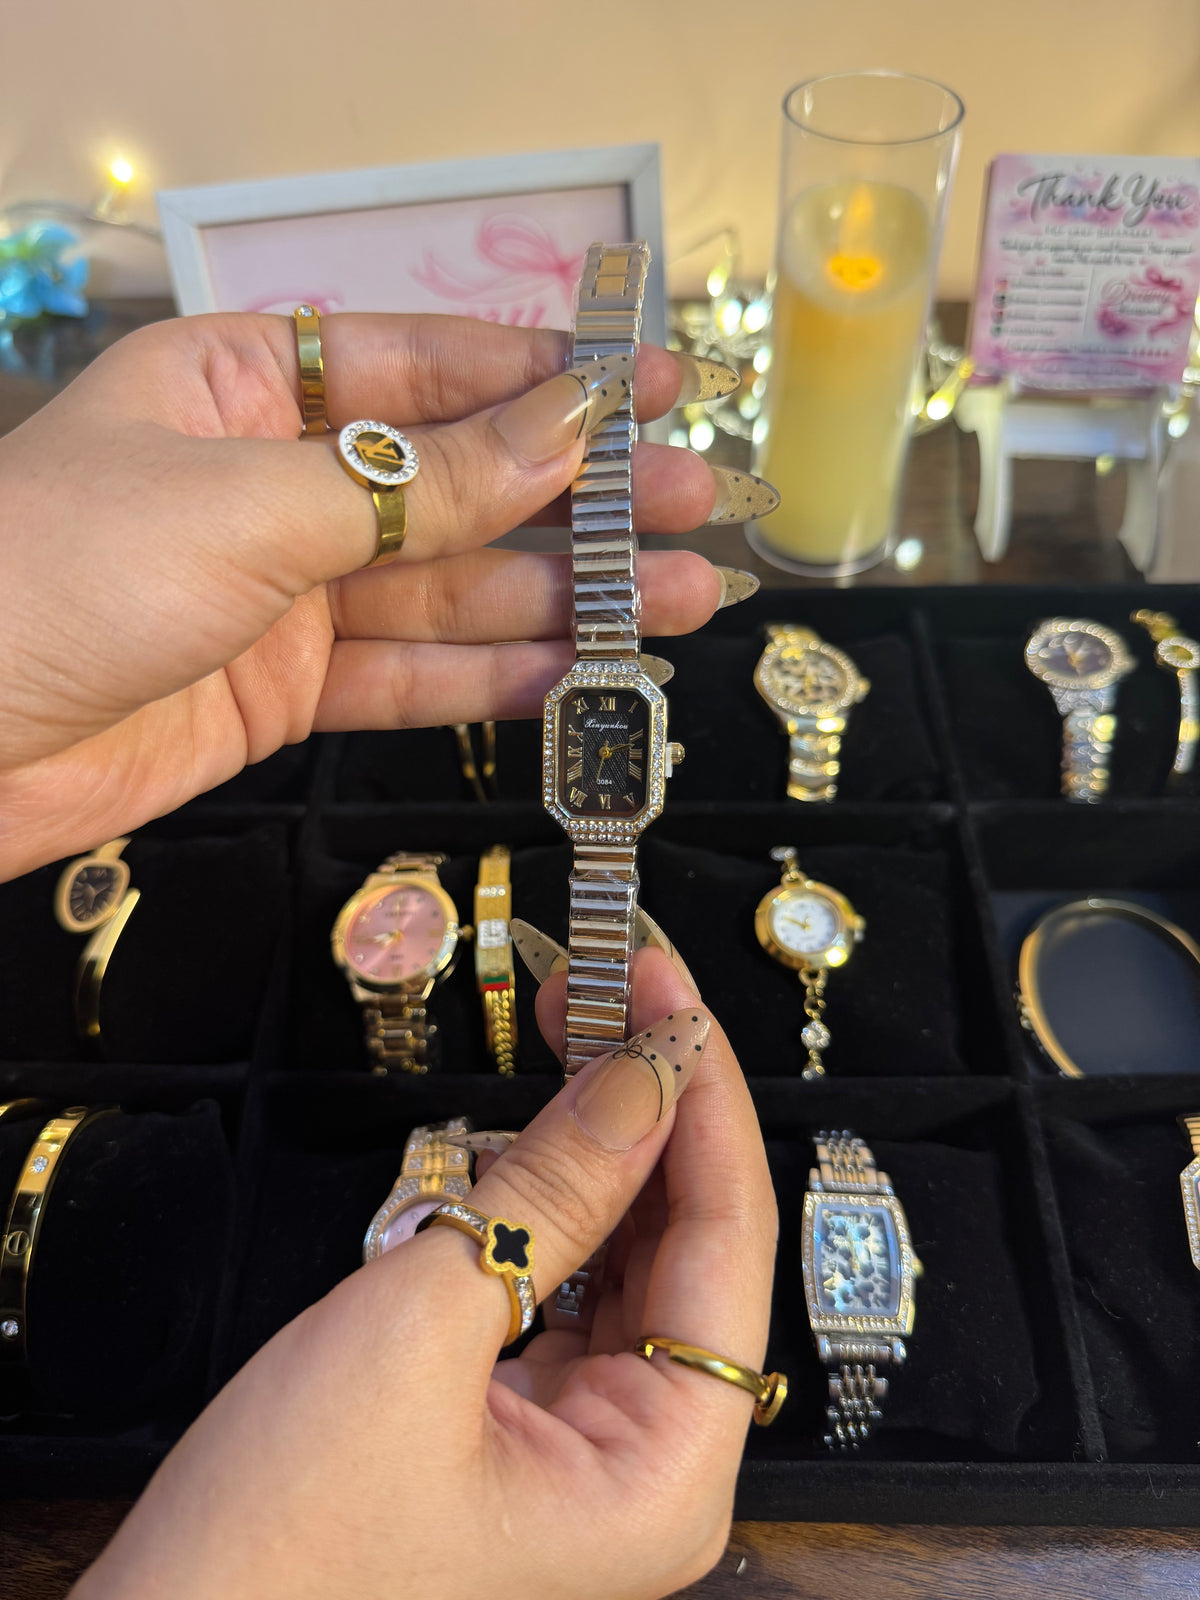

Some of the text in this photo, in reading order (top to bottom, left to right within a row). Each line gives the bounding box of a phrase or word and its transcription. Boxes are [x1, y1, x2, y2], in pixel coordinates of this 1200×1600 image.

[1017, 173, 1194, 227] Thank You
[599, 696, 616, 711] XII
[598, 794, 611, 810] VI
